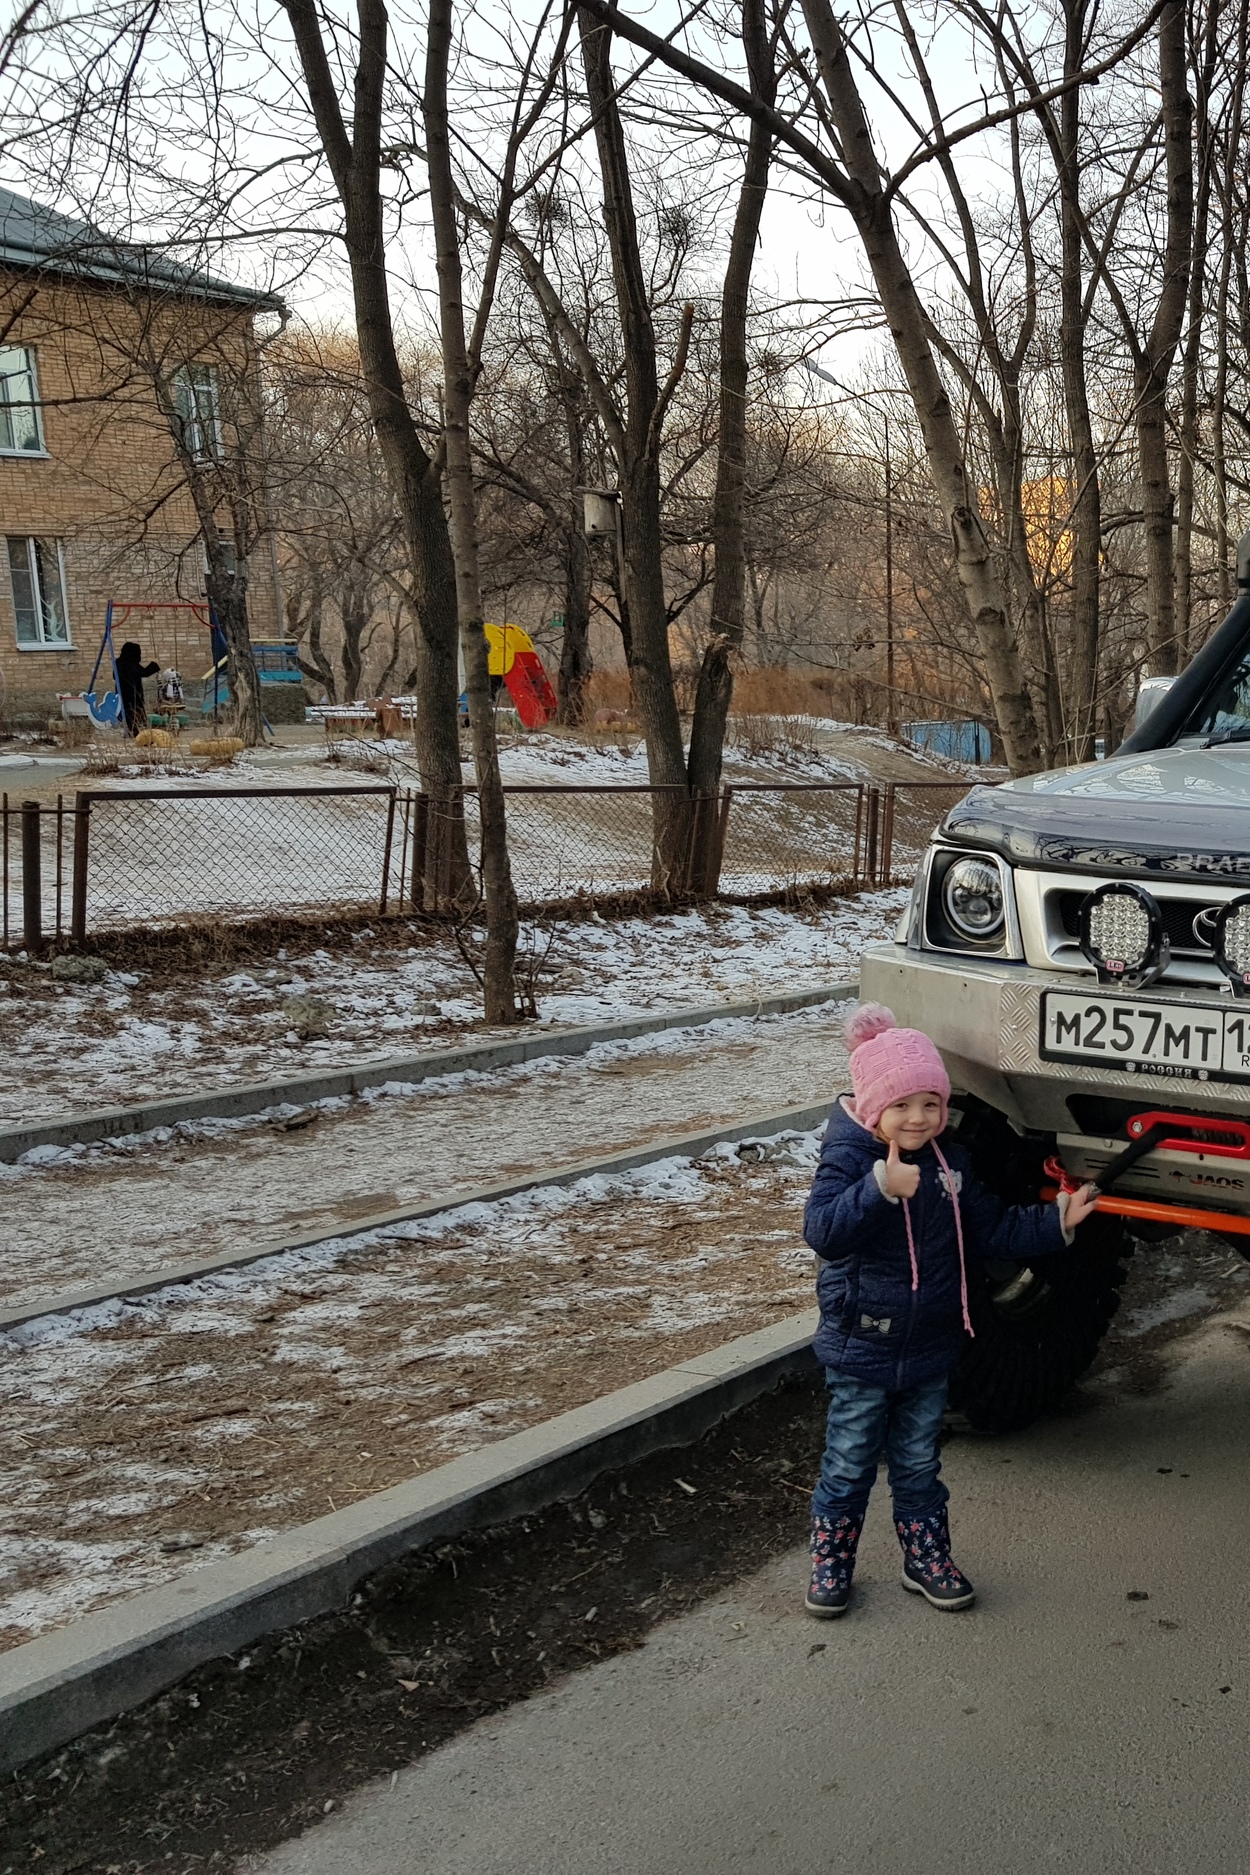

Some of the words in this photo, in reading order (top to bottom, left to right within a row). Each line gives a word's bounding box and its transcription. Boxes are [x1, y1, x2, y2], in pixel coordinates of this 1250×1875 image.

[1109, 961, 1122, 970] LED
[1141, 1063, 1192, 1078] РОССИЯ
[1189, 1174, 1245, 1191] JAOS
